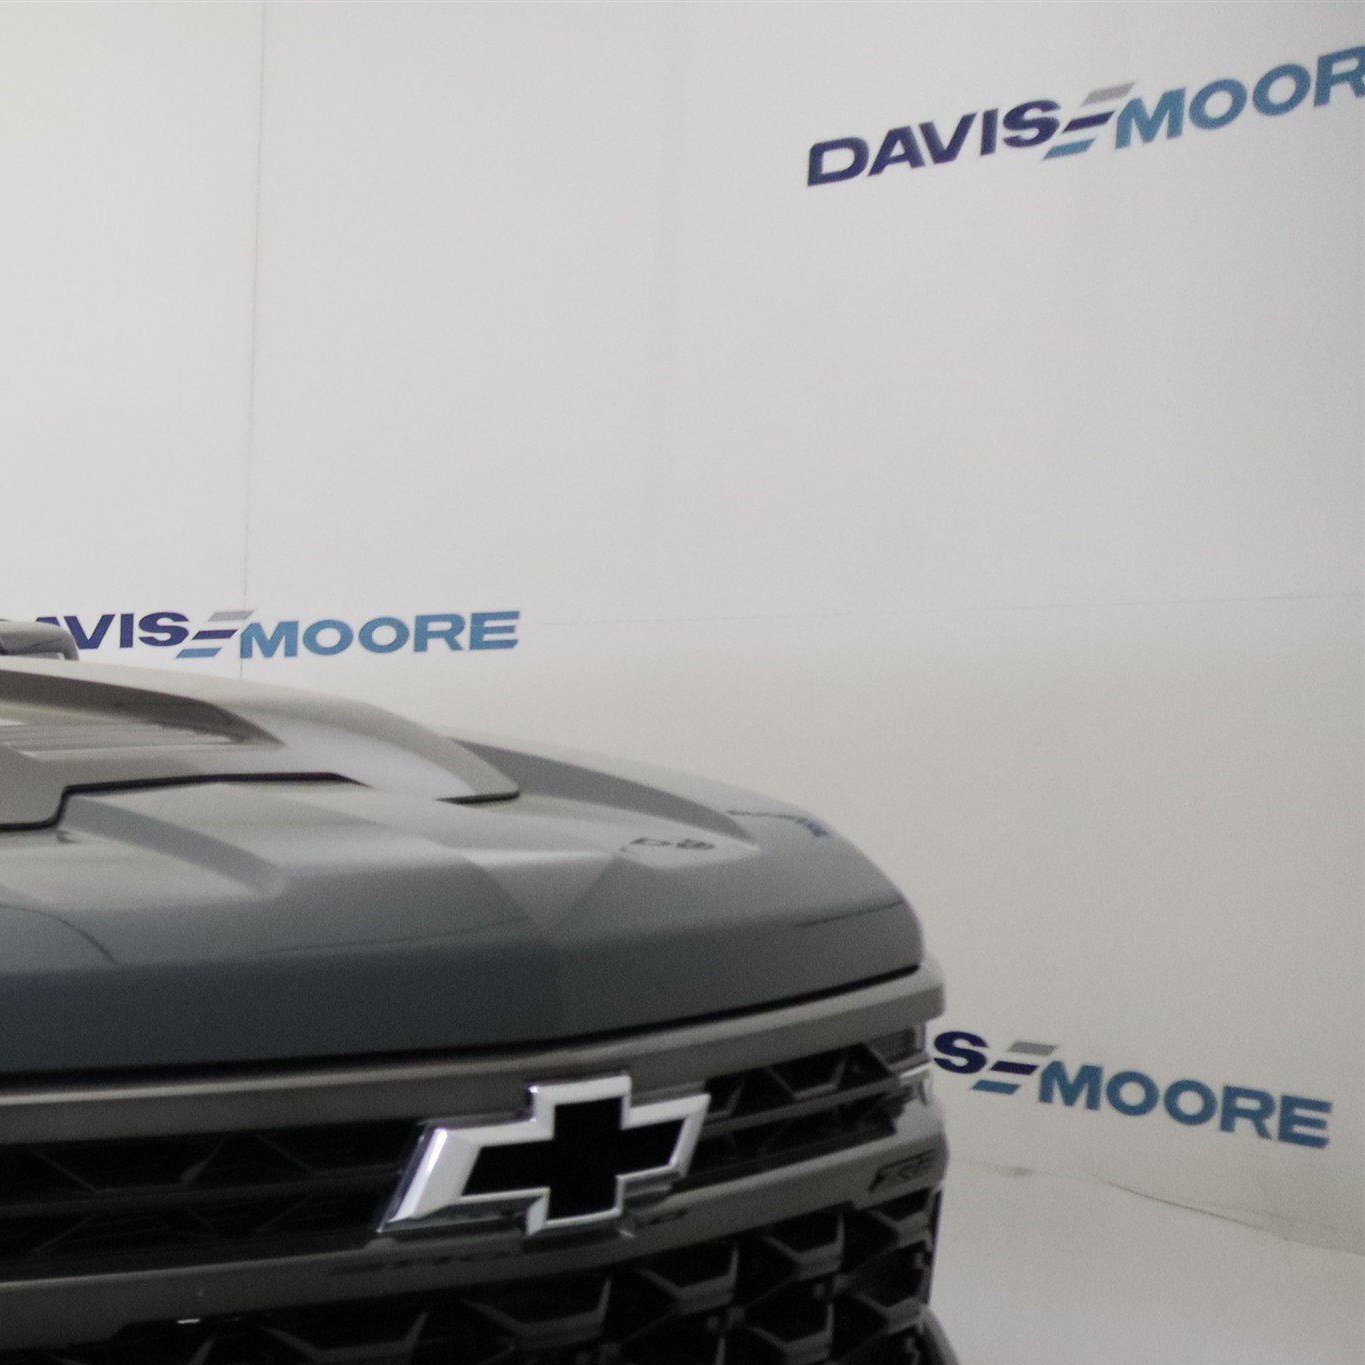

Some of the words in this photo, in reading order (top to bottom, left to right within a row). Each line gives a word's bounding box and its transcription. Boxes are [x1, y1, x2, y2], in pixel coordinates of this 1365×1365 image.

[807, 100, 1059, 187] DAVIS
[1114, 45, 1365, 150] MOOR
[240, 610, 521, 660] MOORE
[1038, 1060, 1333, 1149] MOORE
